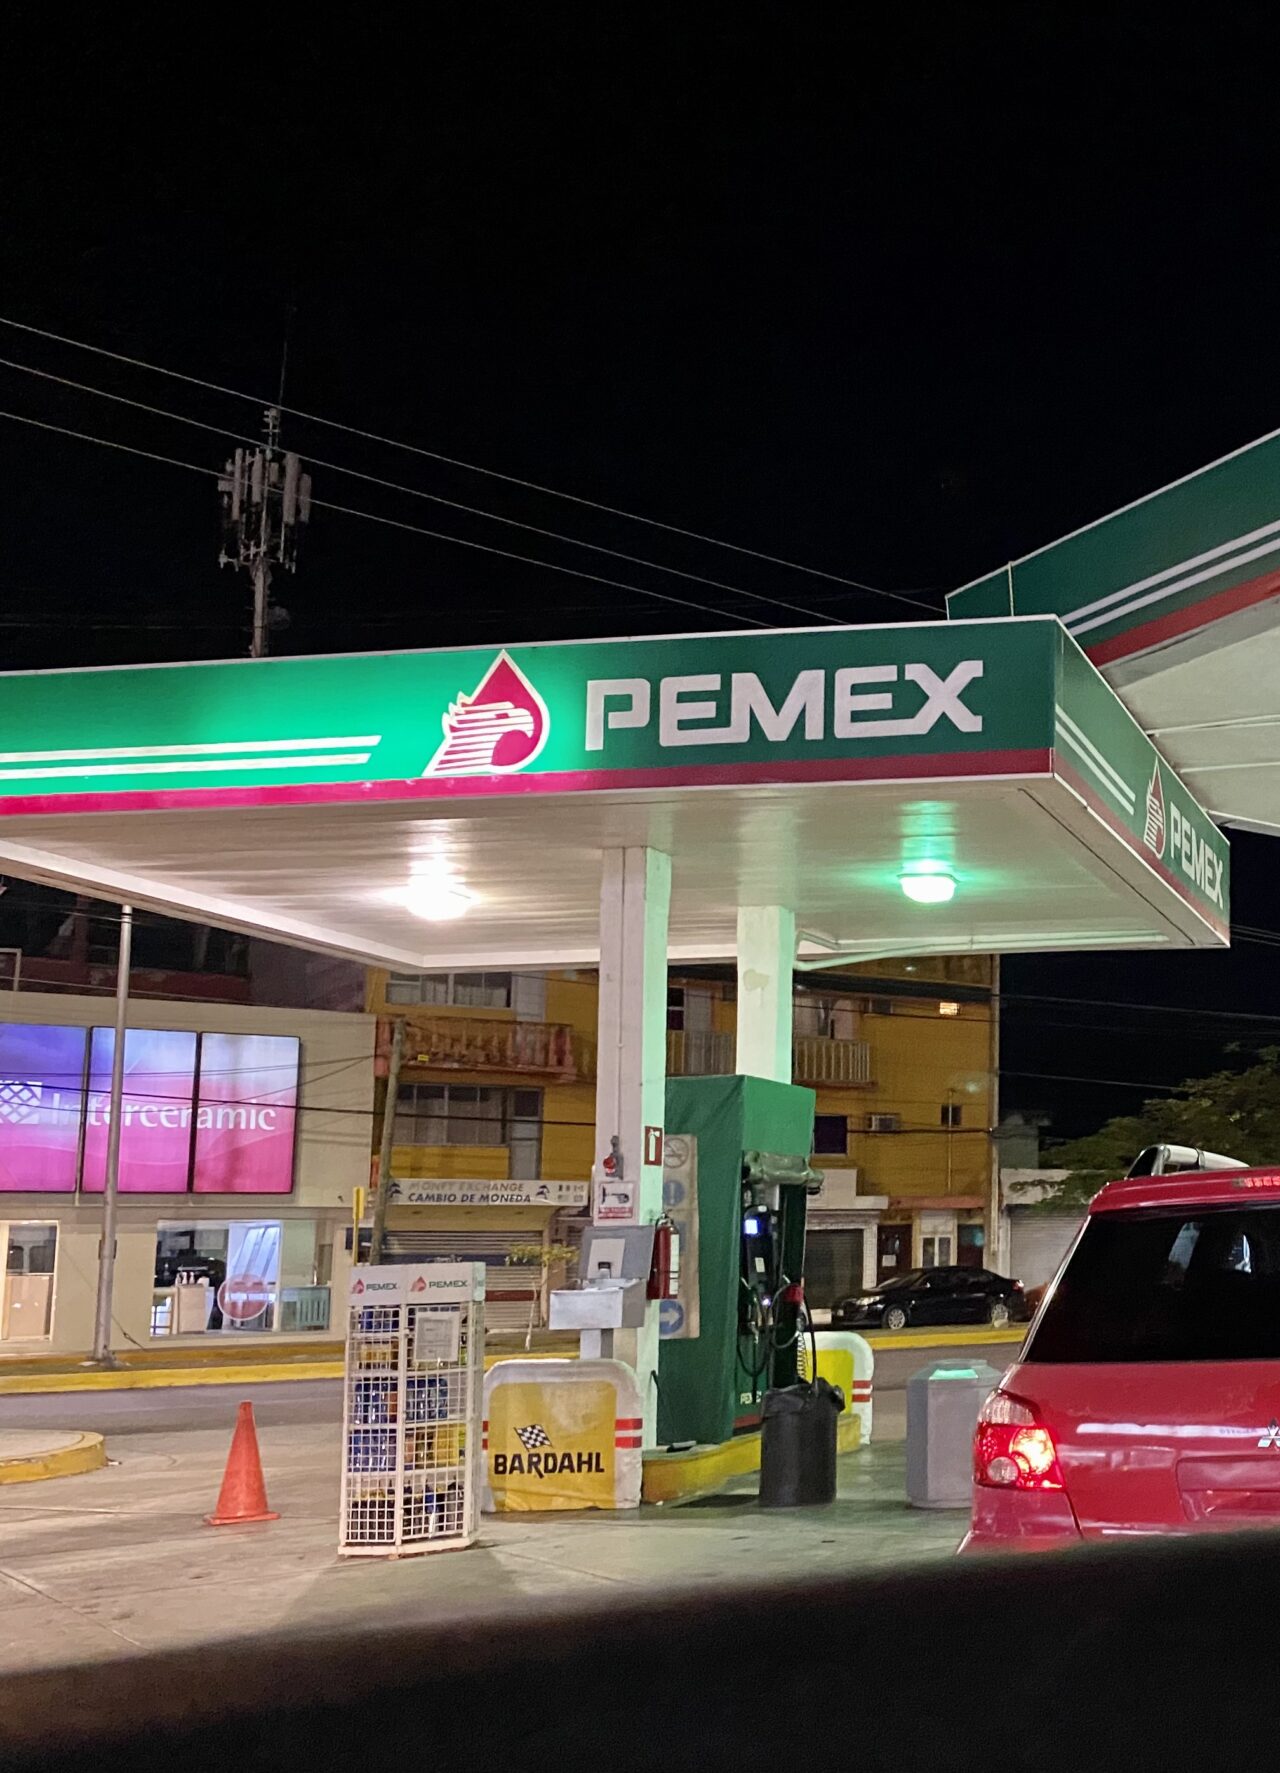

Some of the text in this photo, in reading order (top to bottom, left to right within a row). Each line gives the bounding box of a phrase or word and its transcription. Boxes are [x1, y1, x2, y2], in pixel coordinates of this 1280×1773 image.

[585, 660, 984, 751] PEMEX
[1170, 801, 1223, 910] PEMEX
[408, 1192, 531, 1203] CAMBIO DE MONEDA
[366, 1282, 398, 1291] PEMEX
[428, 1280, 468, 1289] PEMEX
[494, 1452, 605, 1479] BARDAHL
